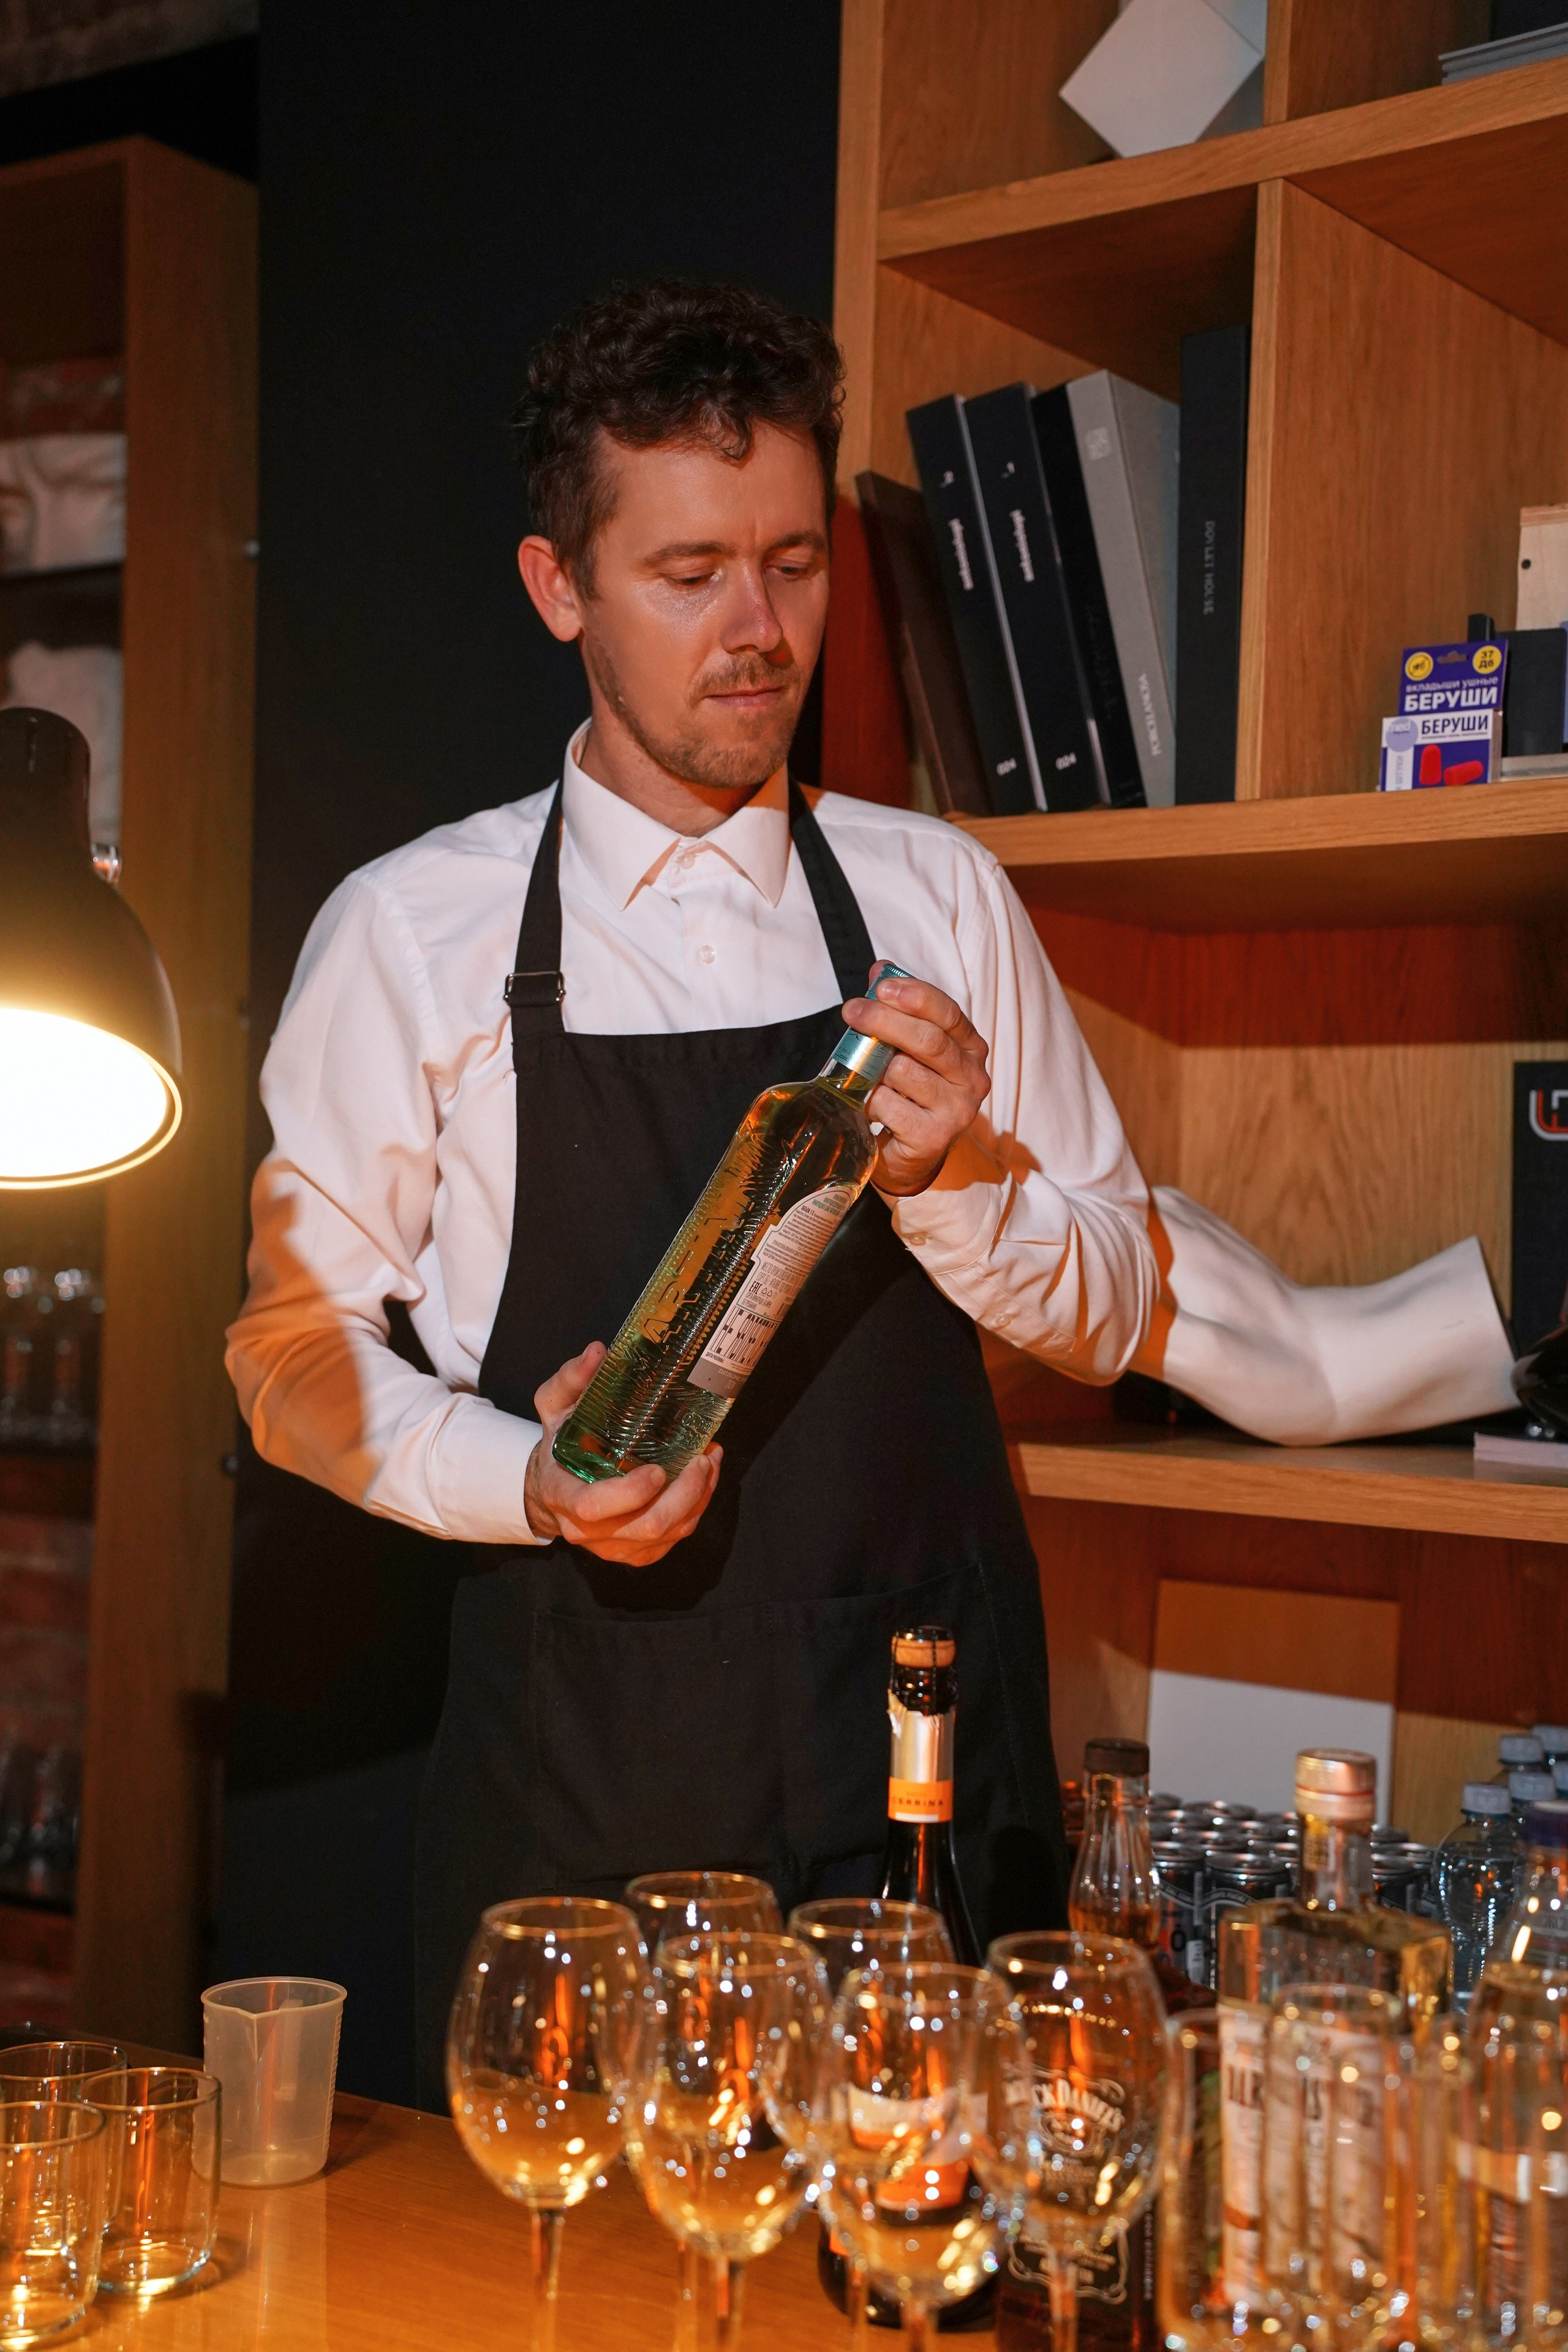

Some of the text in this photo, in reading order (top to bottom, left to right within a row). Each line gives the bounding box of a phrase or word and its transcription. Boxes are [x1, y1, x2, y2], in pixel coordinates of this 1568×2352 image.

[1405, 676, 1499, 693] вкладыши ушные
[1404, 687, 1498, 712] БЕРУШИ
[1421, 715, 1488, 735] БЕРУШИ
